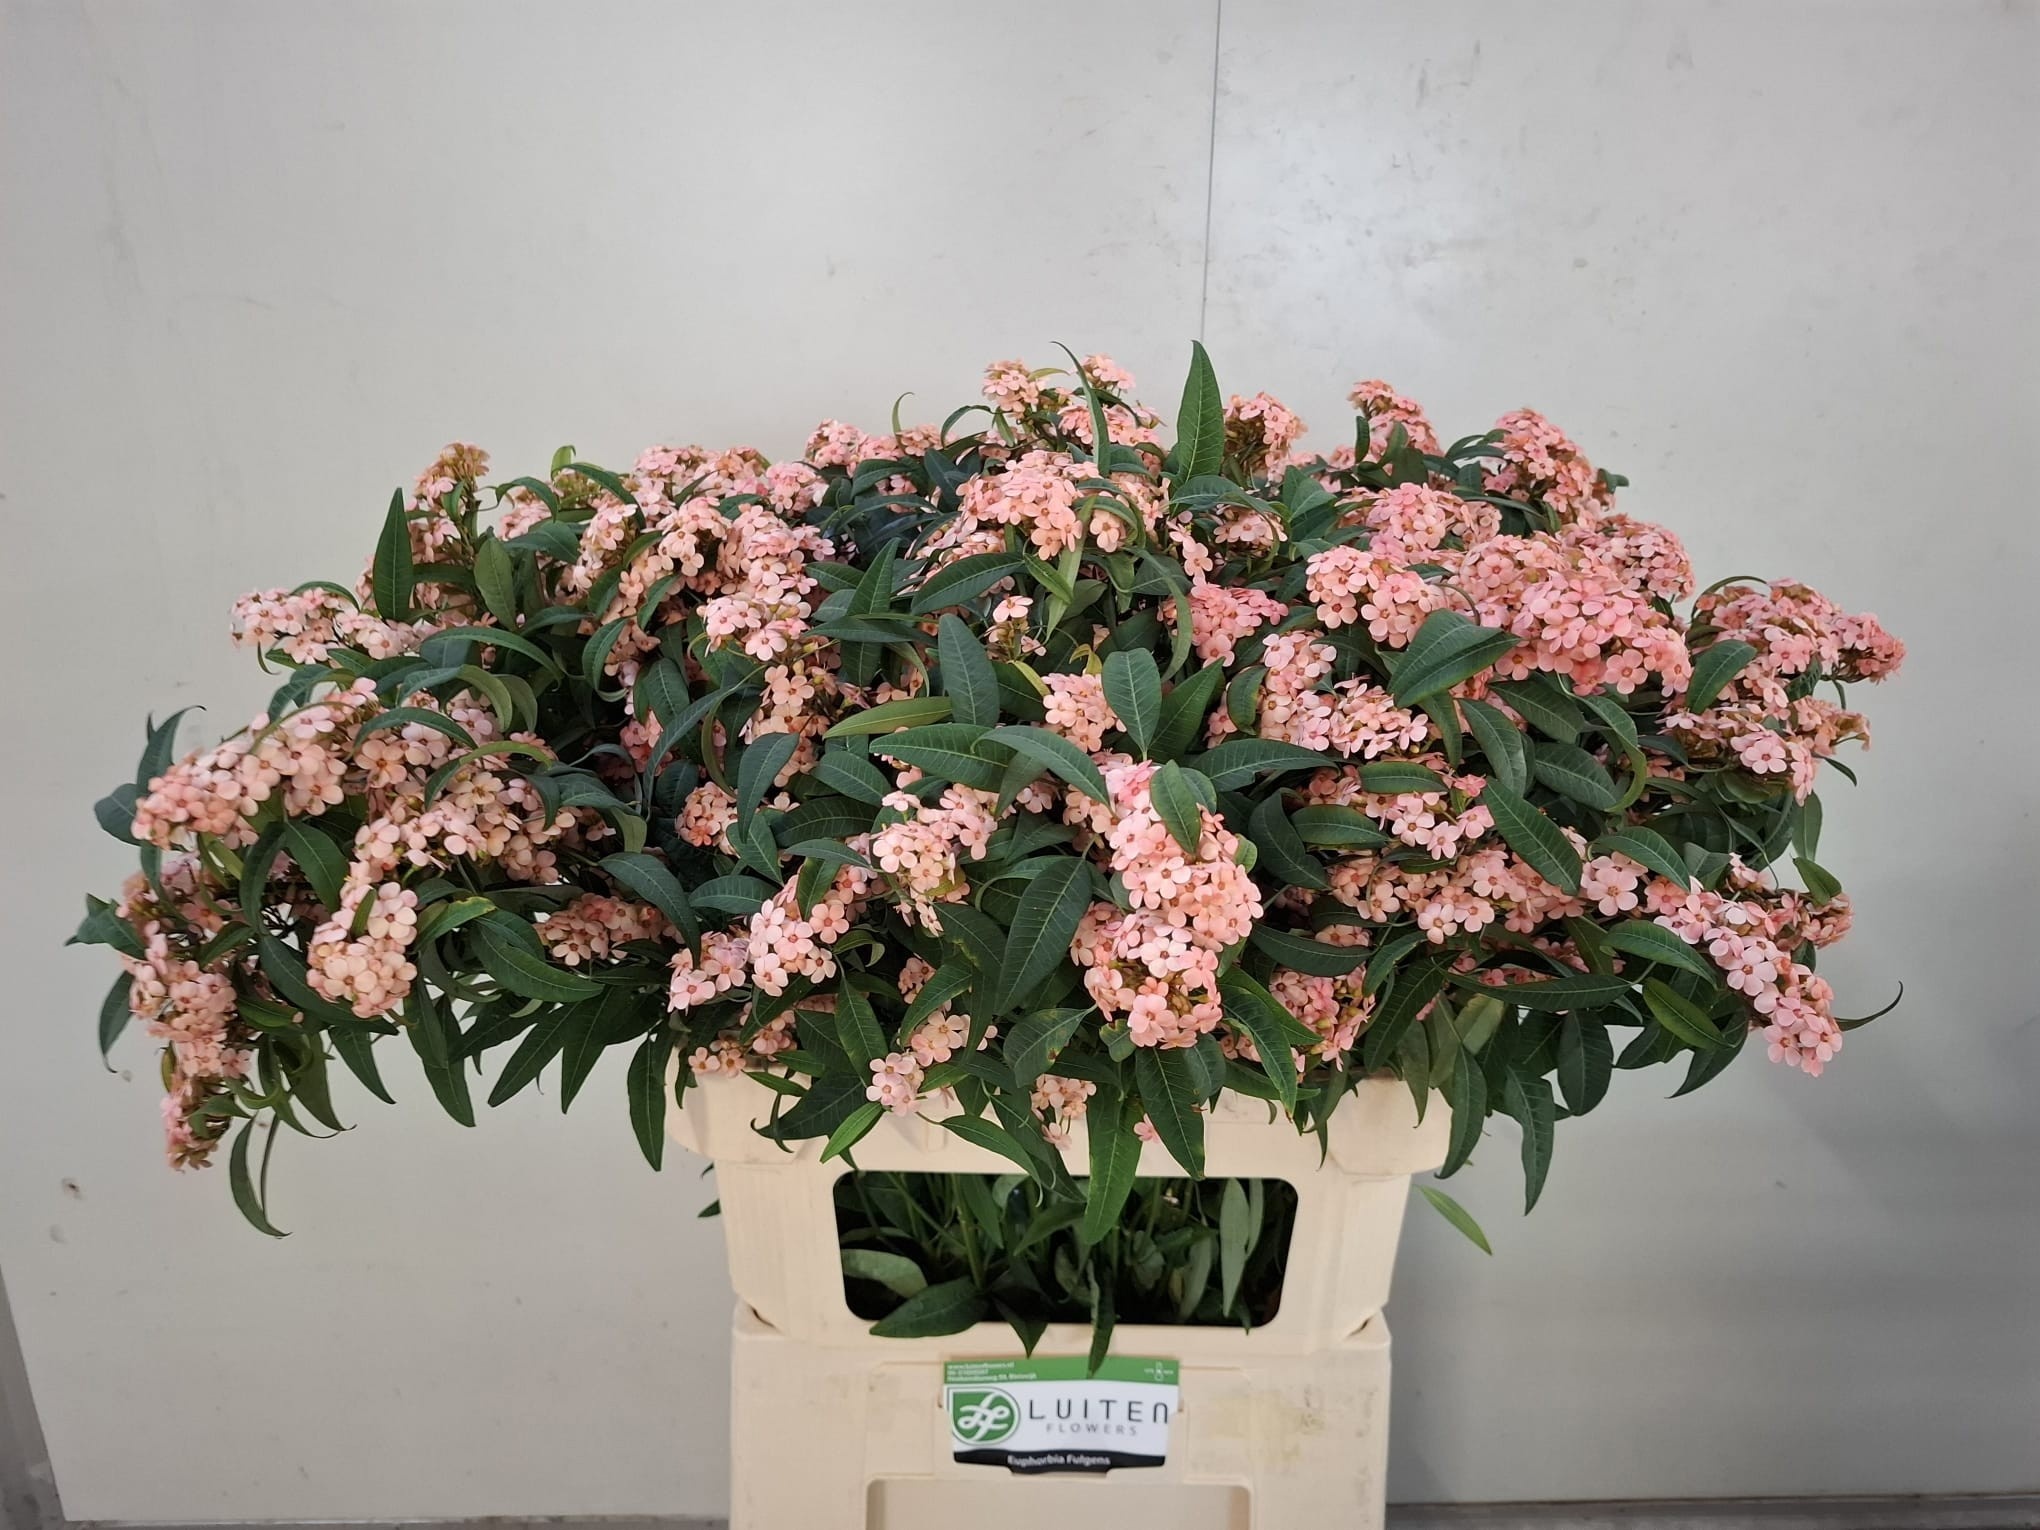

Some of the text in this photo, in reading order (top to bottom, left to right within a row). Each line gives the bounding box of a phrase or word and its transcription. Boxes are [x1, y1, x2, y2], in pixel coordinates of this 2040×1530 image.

[1046, 1423, 1138, 1436] FLOWERS
[1007, 1454, 1111, 1468] Euphorbia Fulgens
